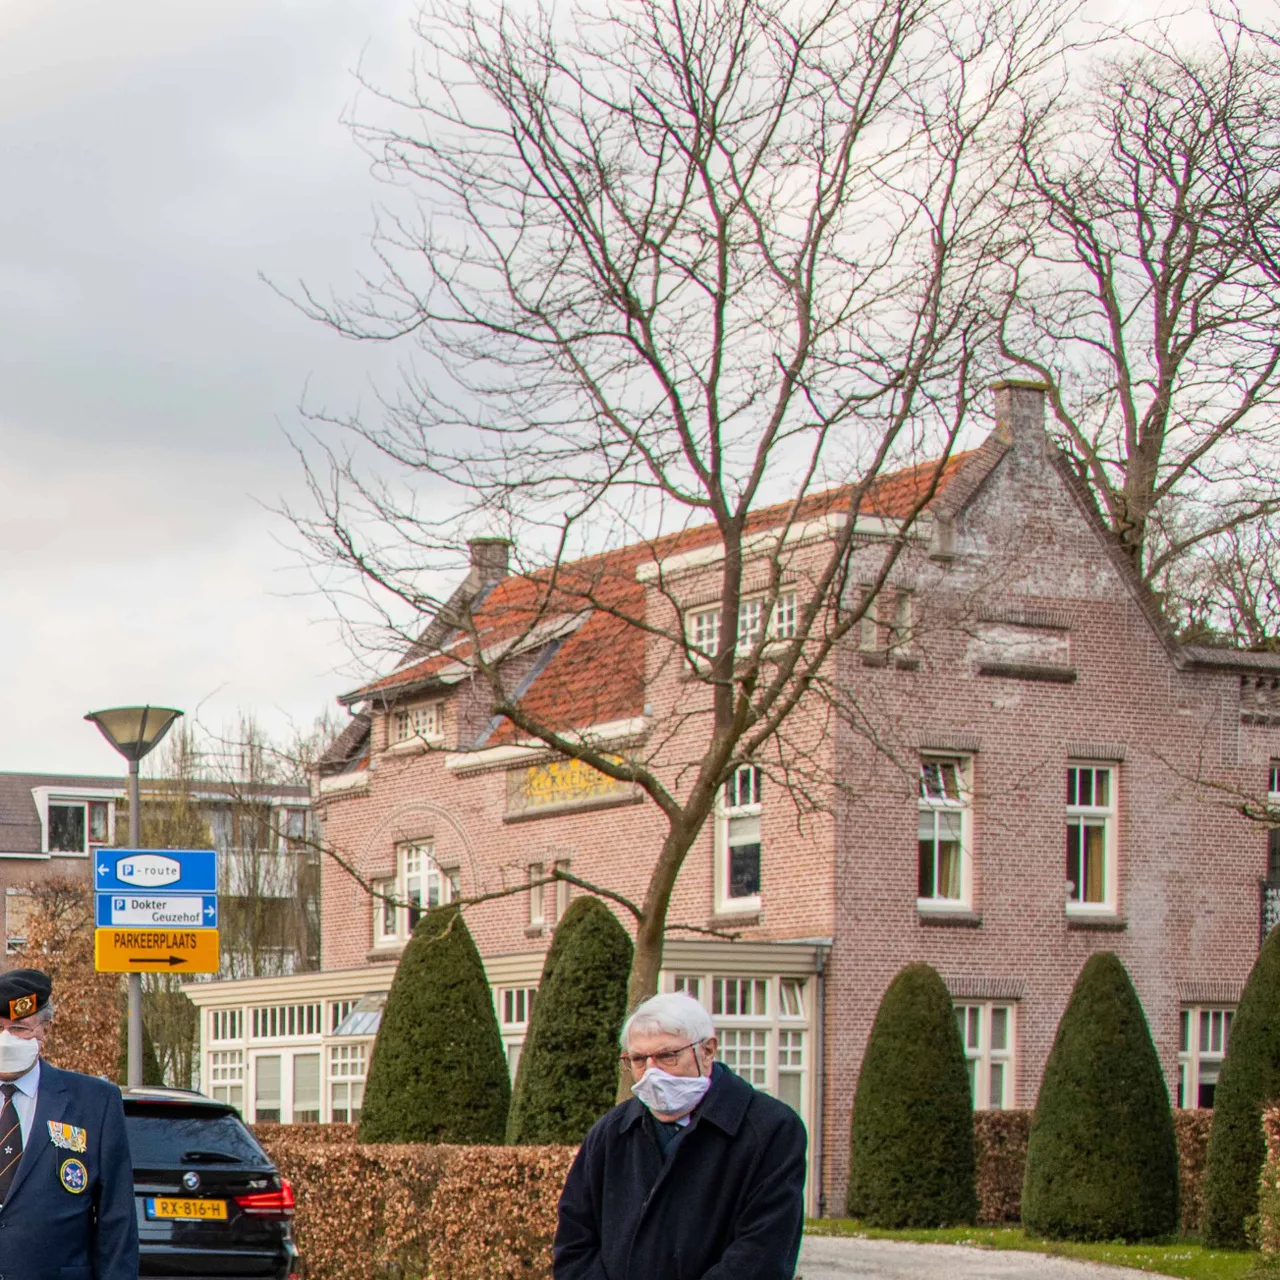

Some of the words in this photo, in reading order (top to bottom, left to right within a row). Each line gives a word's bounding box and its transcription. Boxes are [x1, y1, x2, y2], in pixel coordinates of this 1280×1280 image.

[145, 866, 177, 875] route
[131, 899, 167, 910] Dokter
[151, 911, 200, 922] Geuzehof
[113, 932, 197, 949] PARKEERPLAATS
[160, 1201, 221, 1216] RX-816-H
